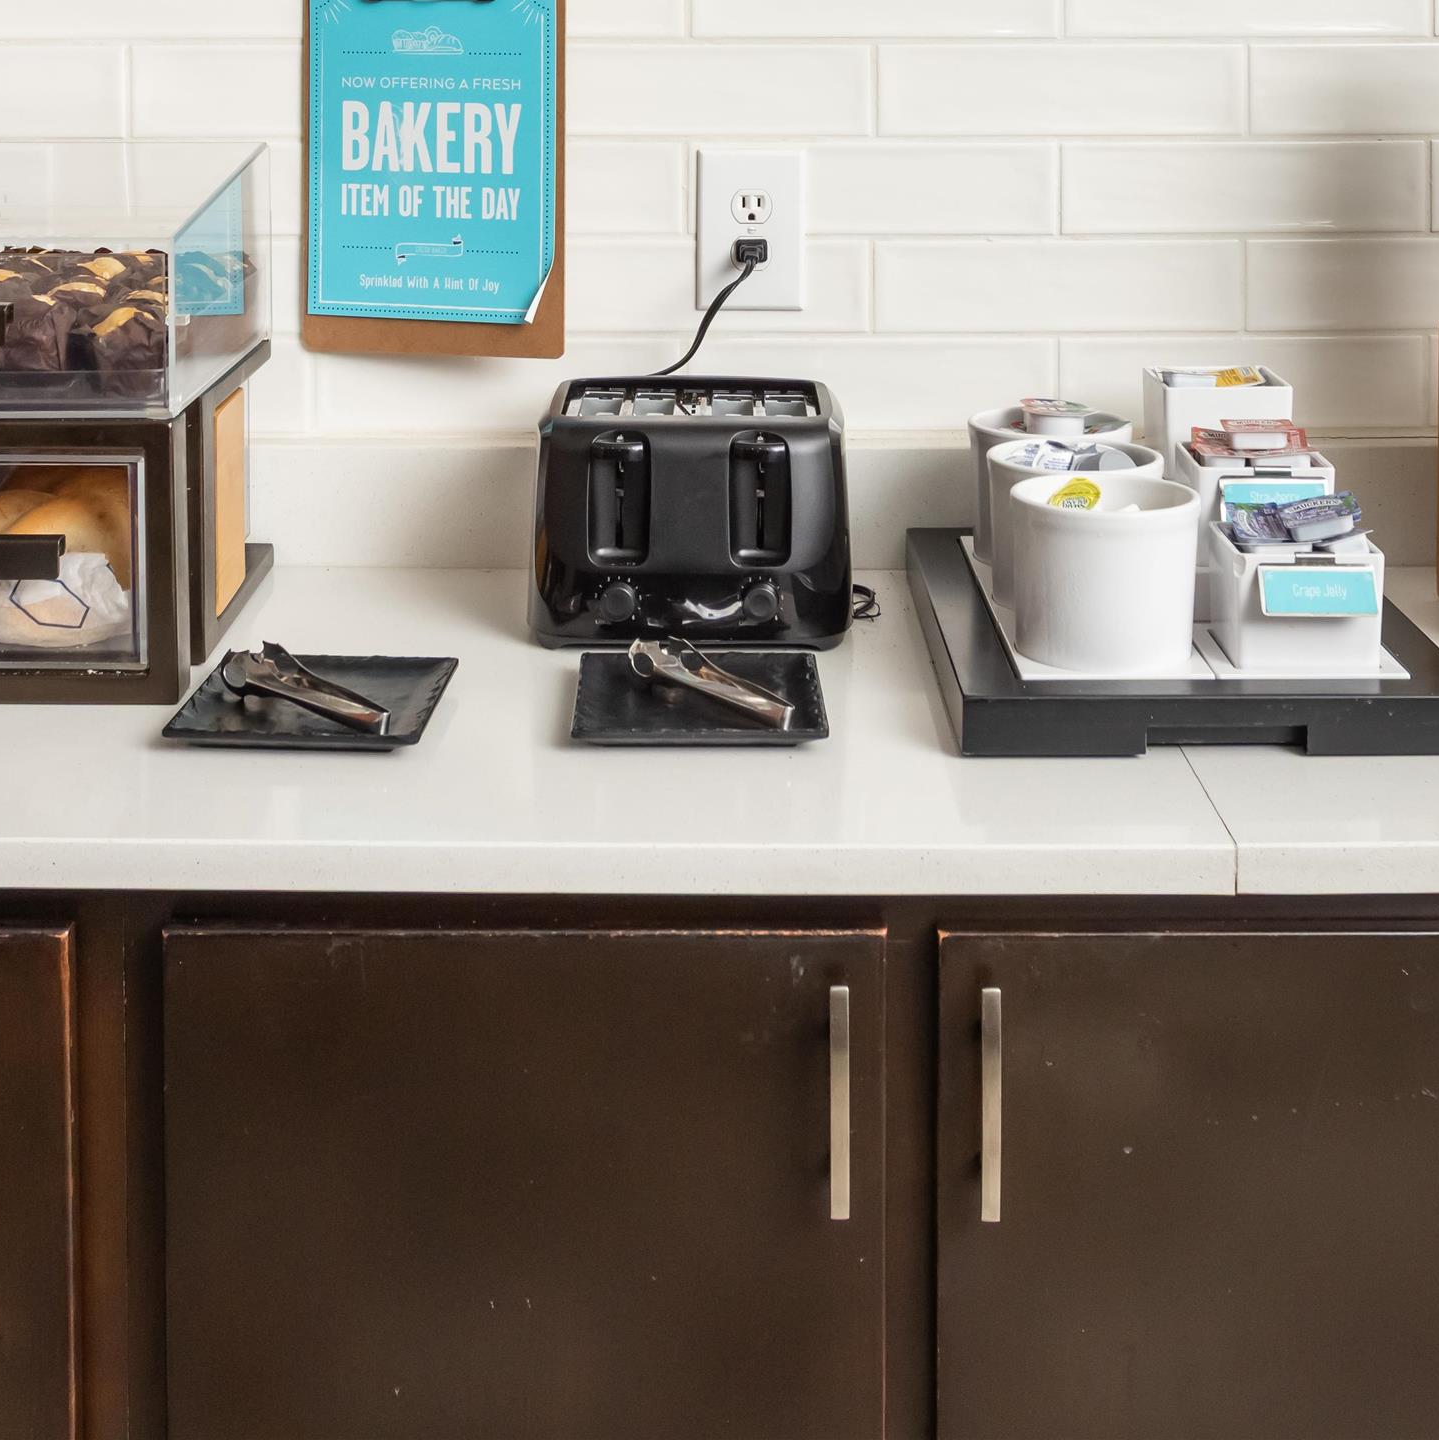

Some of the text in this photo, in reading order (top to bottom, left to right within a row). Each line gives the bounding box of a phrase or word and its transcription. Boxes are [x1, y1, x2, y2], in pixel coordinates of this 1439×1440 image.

[341, 76, 522, 91] NOW OFFERING A FRESH
[341, 100, 523, 175] BAKERY
[341, 183, 521, 221] ITEM OF THE DAY
[359, 273, 500, 295] Sprinkled With A Hint Of Joy
[1292, 583, 1347, 600] Grape Jelly
